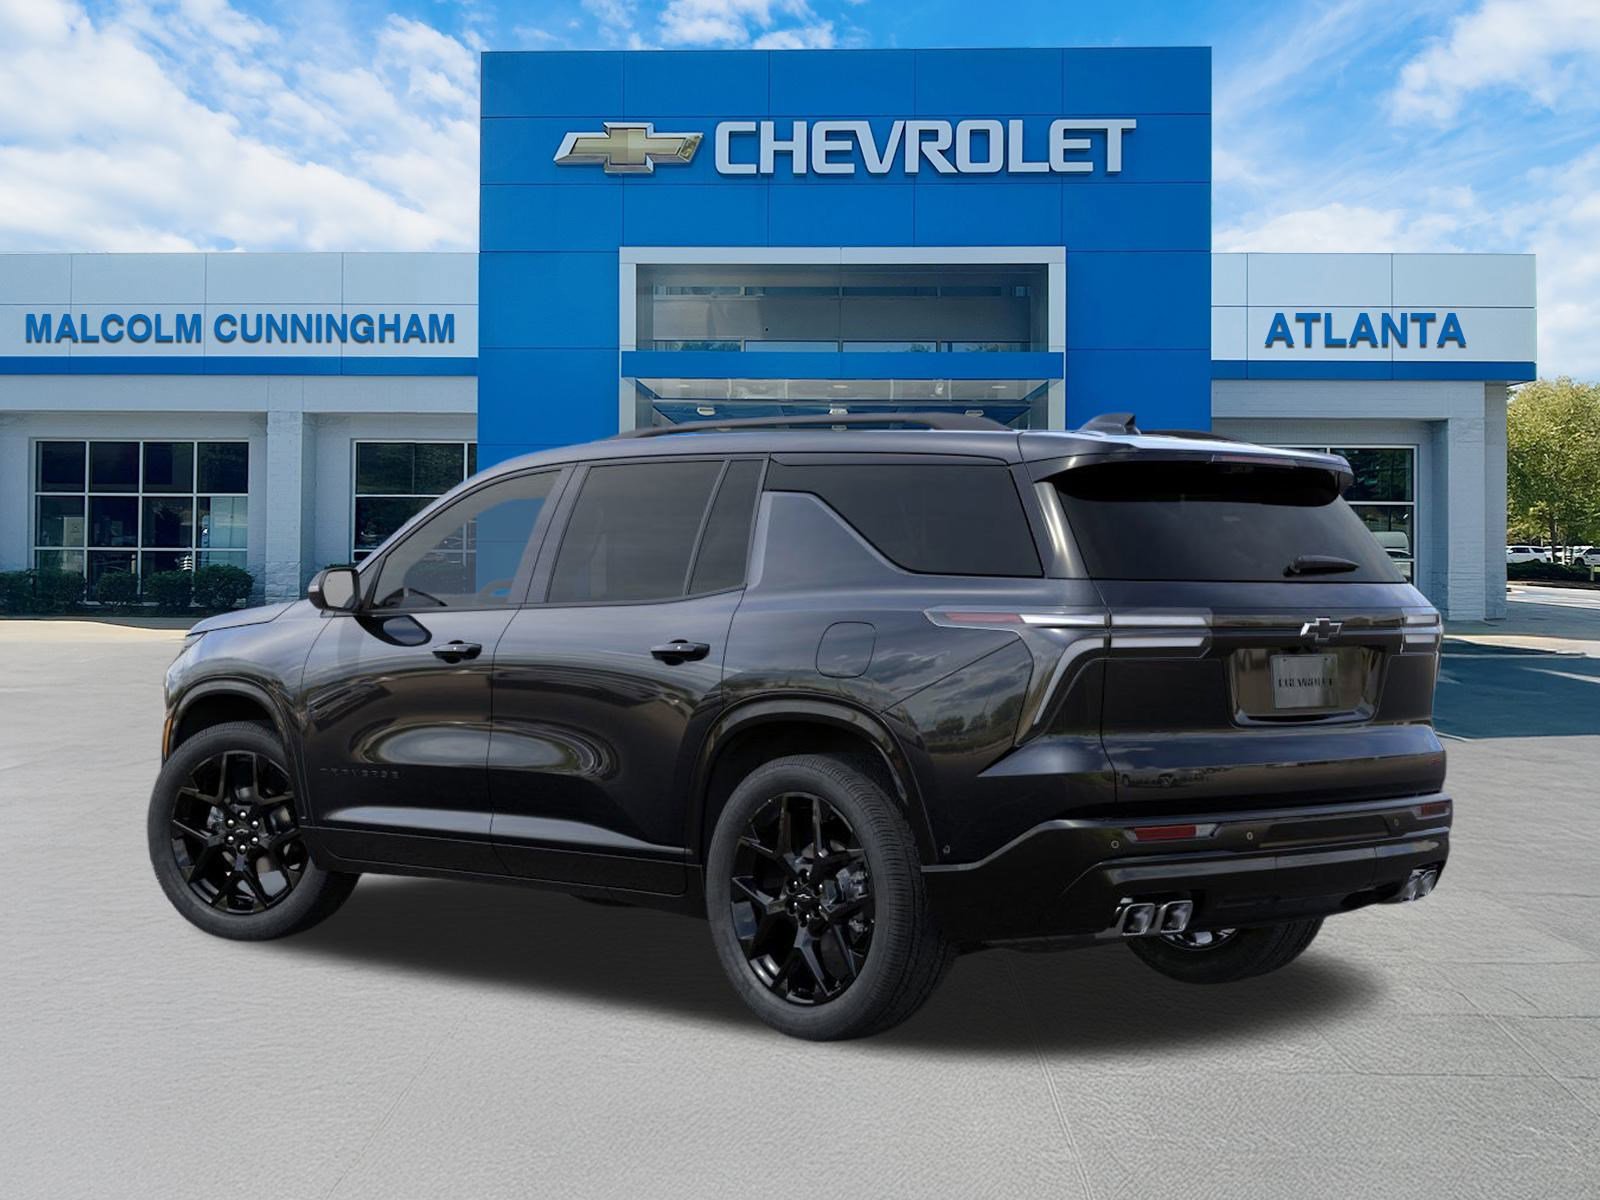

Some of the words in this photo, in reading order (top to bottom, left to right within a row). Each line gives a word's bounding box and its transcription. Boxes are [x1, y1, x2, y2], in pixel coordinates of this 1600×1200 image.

[714, 118, 1137, 175] CHEVROLET
[25, 313, 202, 344] MALCOLM
[213, 313, 456, 344] CUNNINGHAM
[1264, 312, 1467, 348] ATLANTA
